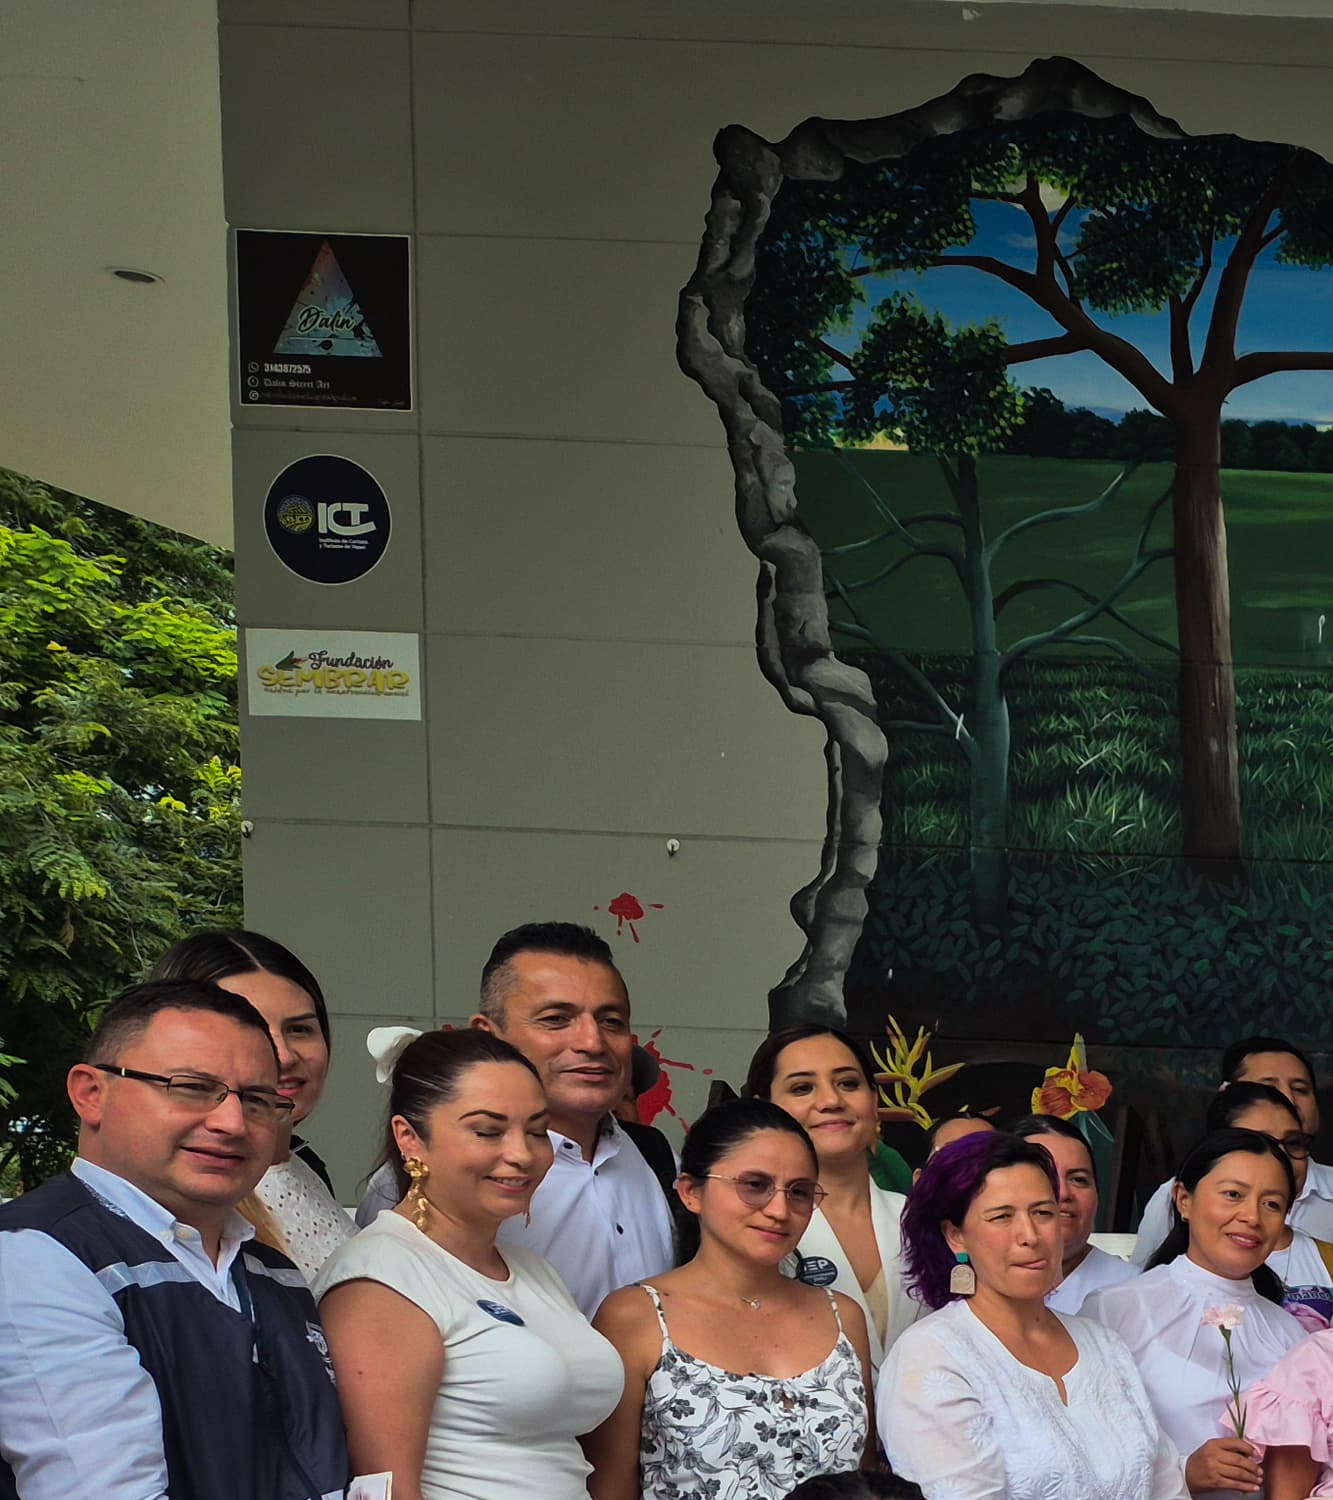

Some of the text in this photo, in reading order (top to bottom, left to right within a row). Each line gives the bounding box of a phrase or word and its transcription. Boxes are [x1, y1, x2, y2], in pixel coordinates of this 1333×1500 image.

[317, 502, 377, 536] ICT
[308, 650, 394, 670] Fundación
[257, 664, 411, 692] SEMBRAR
